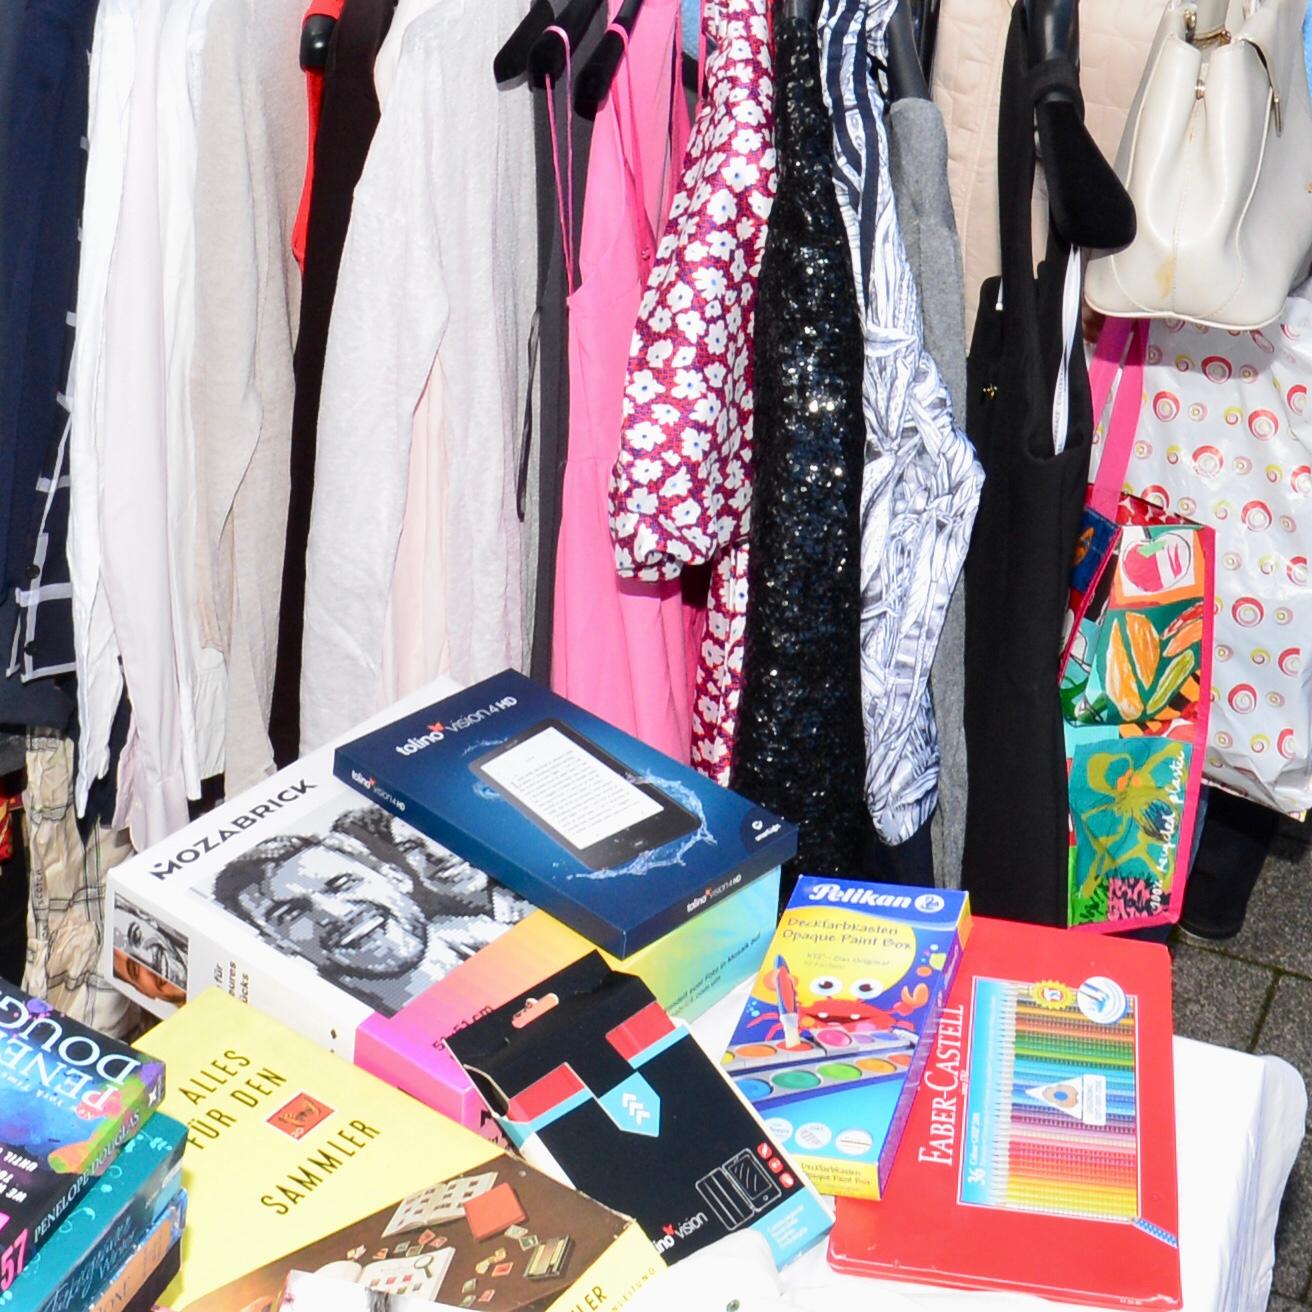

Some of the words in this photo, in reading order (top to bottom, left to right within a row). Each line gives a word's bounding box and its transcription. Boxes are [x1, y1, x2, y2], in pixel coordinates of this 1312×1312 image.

[396, 729, 445, 756] tolino
[446, 709, 490, 732] vision
[488, 704, 499, 716] 4
[495, 696, 518, 711] HD
[351, 769, 371, 789] tolino
[373, 786, 393, 803] vision
[395, 801, 406, 811] HD
[149, 778, 318, 881] MOZABRICK
[808, 883, 912, 909] Pelikan
[783, 930, 837, 942] Opaque
[841, 931, 877, 947] Paint
[882, 935, 912, 950] Box
[788, 917, 898, 936] Deckfarbkasten
[240, 973, 249, 1003] ücks
[178, 1049, 250, 1106] ALLES
[918, 1004, 964, 1166] FABER-CASTELL
[187, 1108, 237, 1150] FÜR
[230, 1067, 287, 1108] DEN
[3, 1151, 39, 1172] UNTIL
[34, 1170, 89, 1244] PENELOPE
[90, 1108, 140, 1176] DOUGLAS
[260, 1119, 381, 1216] SAMMLER
[5, 1188, 27, 1203] WE
[653, 1234, 675, 1253] ino
[676, 1211, 708, 1239] vision
[0, 1228, 29, 1291] 57
